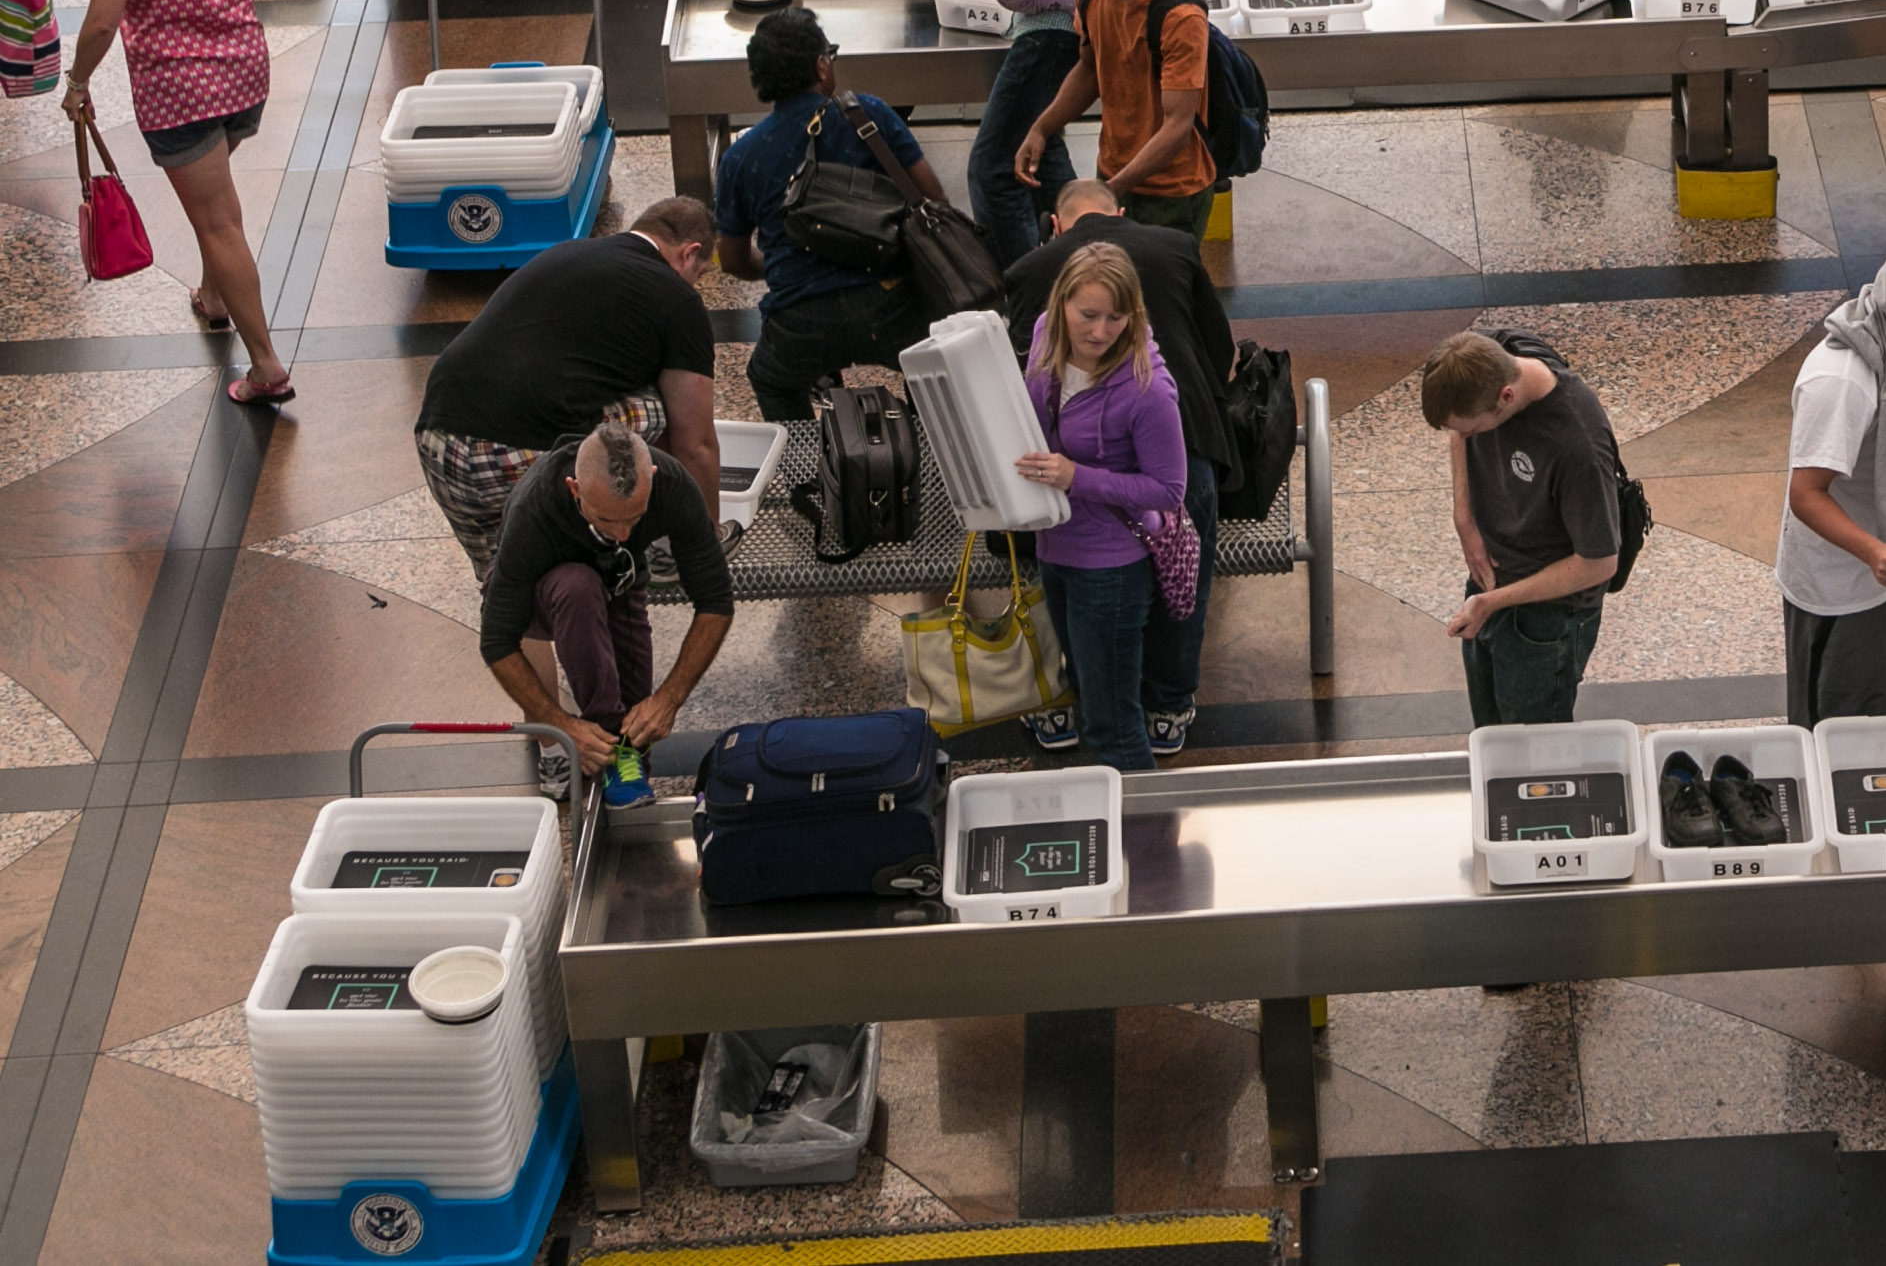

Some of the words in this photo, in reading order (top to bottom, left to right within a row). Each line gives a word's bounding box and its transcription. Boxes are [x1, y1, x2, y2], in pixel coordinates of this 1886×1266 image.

[1682, 3, 1718, 14] B76
[968, 9, 1000, 22] A24
[1290, 21, 1326, 34] A35
[1088, 825, 1097, 853] BECAUSE
[1088, 855, 1097, 868] YOU
[1538, 854, 1583, 869] A01
[1714, 862, 1761, 876] B89
[1010, 907, 1058, 921] B74
